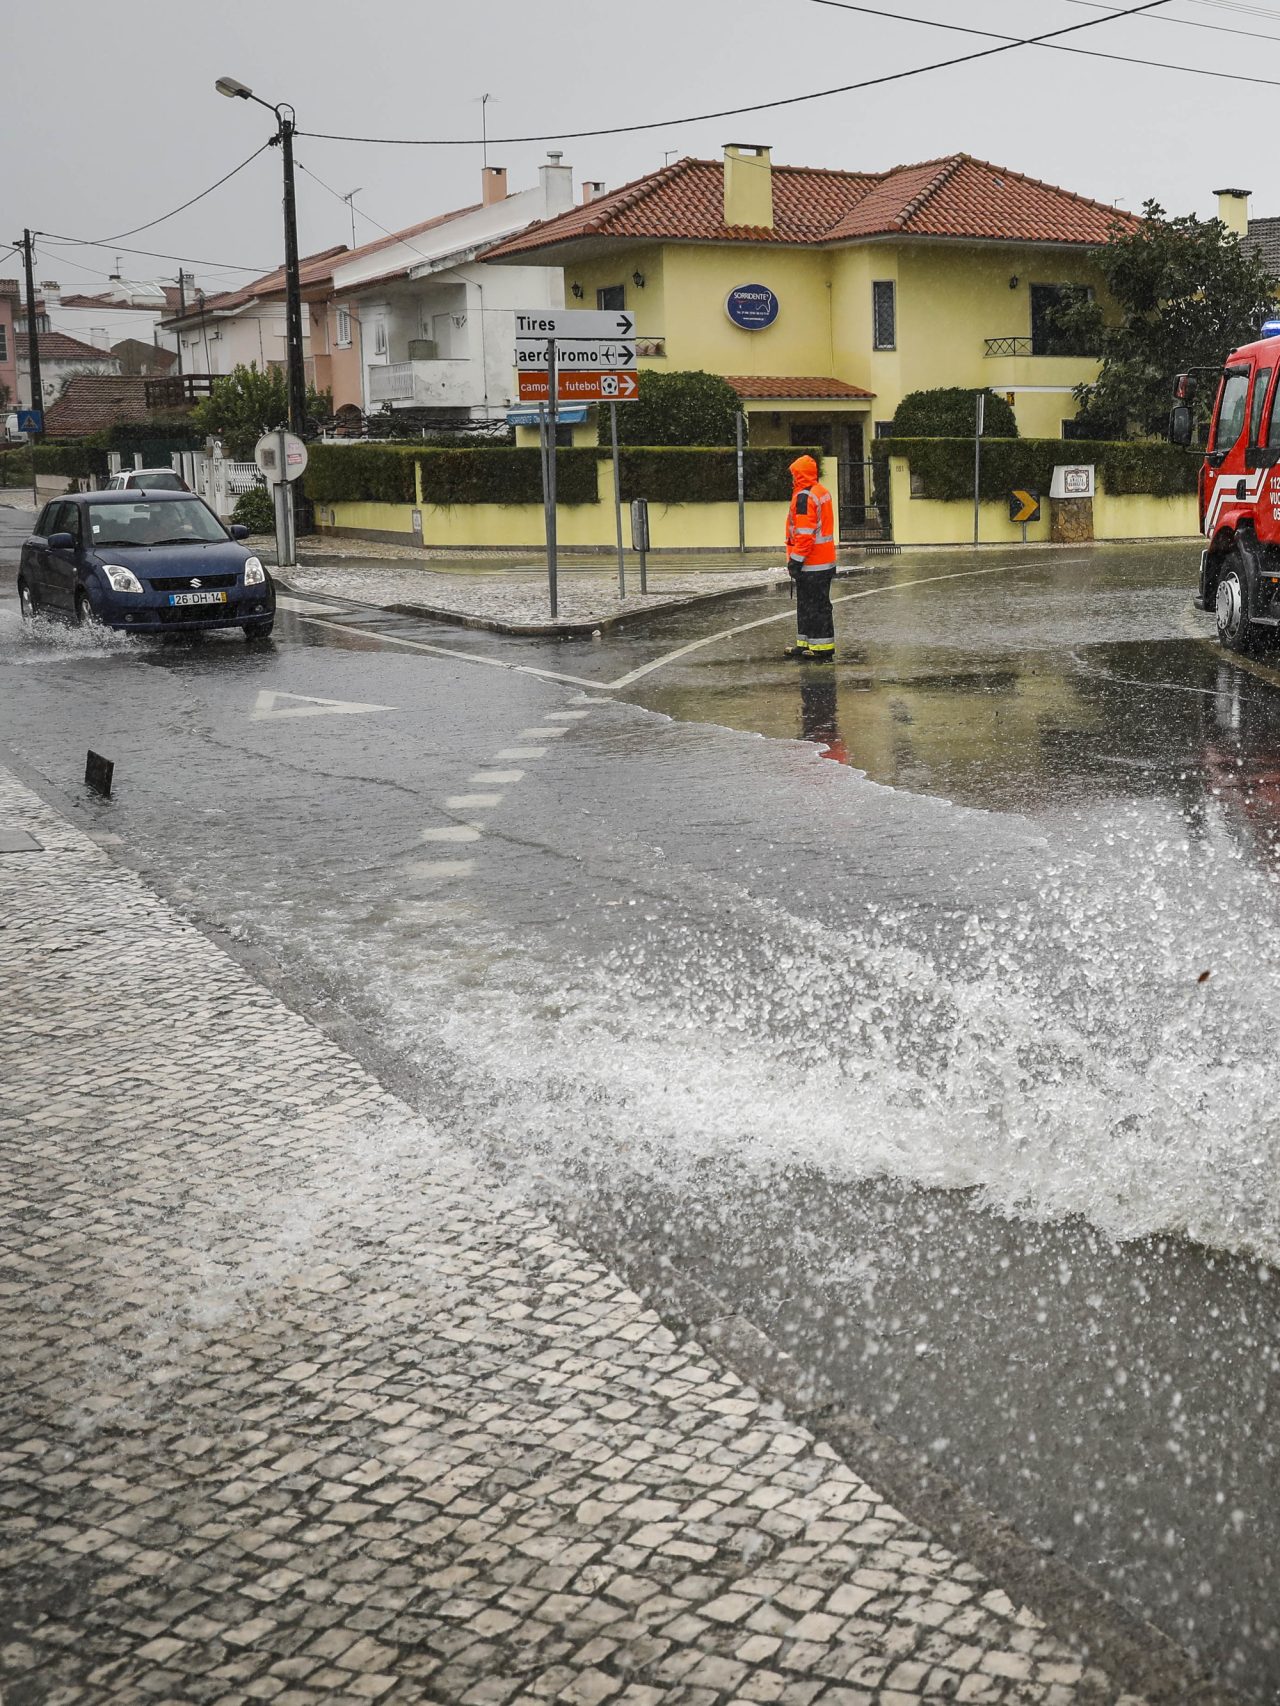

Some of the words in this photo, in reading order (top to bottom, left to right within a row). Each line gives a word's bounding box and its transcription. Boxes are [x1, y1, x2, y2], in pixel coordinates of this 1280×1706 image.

[734, 291, 767, 300] SORRIDENTE
[517, 316, 555, 331] Tires
[565, 381, 600, 391] futebol
